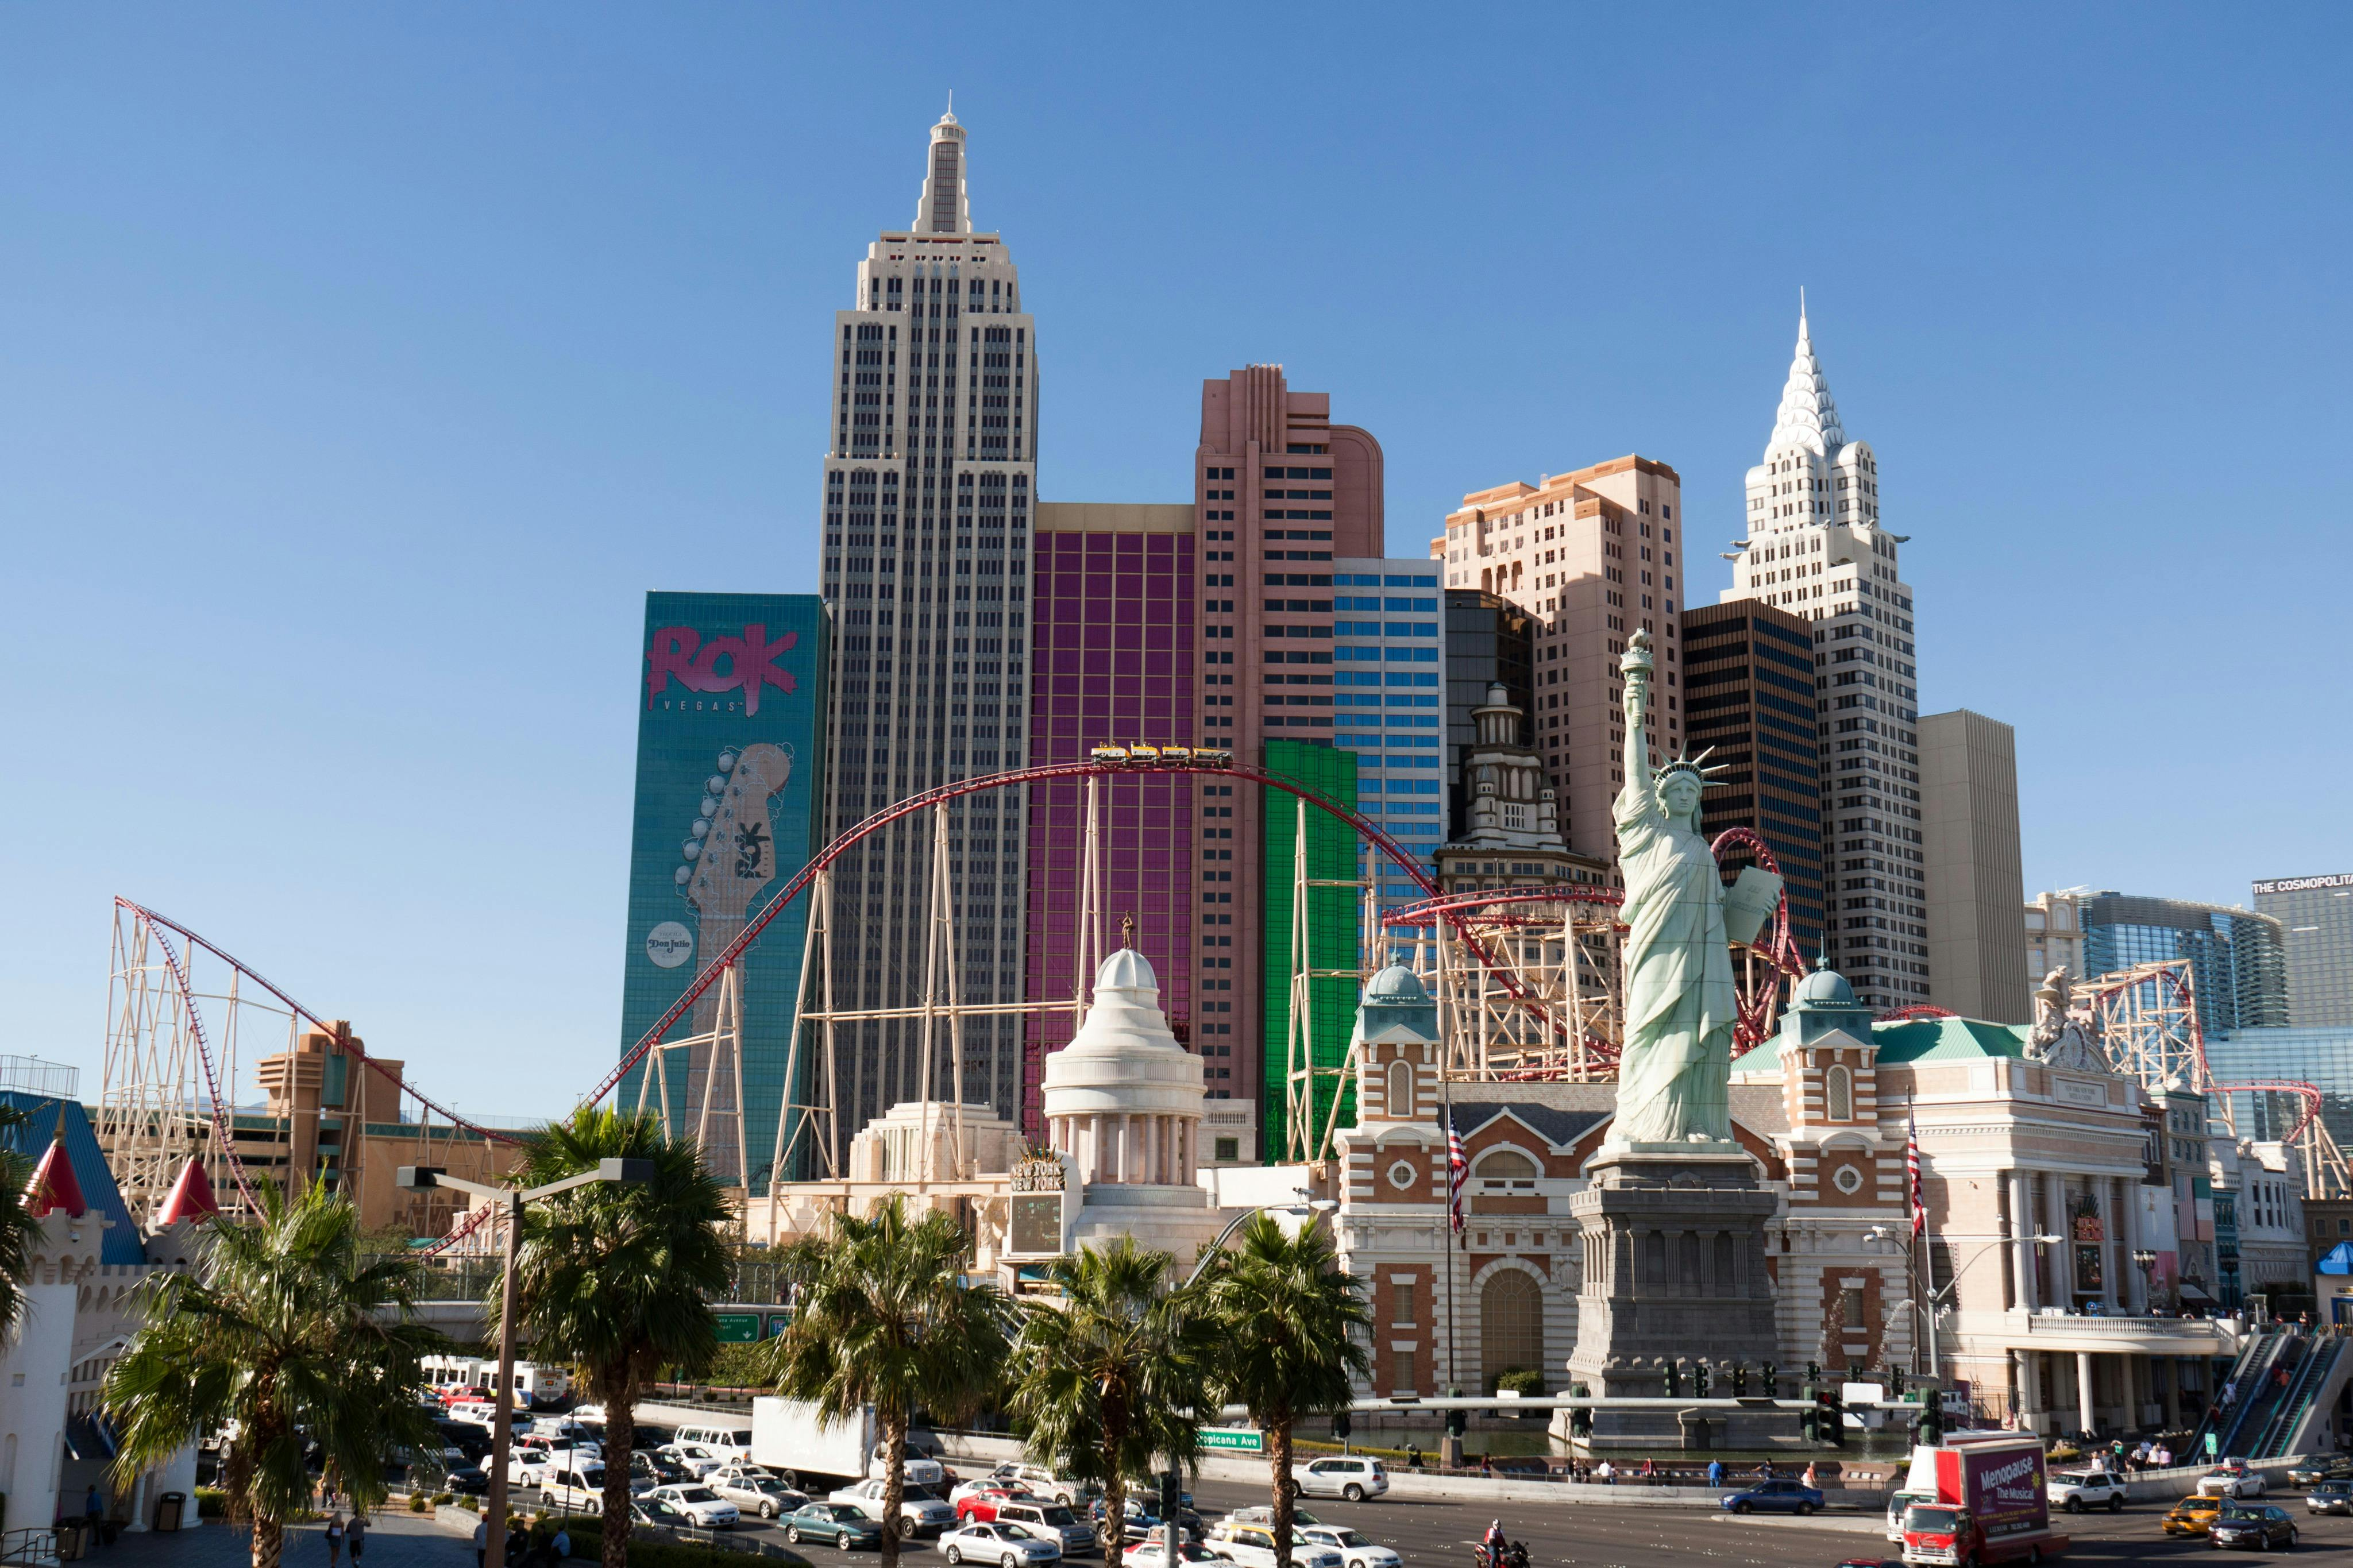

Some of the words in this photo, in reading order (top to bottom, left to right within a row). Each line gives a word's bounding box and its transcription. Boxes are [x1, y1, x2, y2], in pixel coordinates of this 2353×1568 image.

[646, 623, 799, 718] ROK
[2251, 882, 2275, 894] THE
[648, 939, 669, 949] Don
[667, 939, 690, 953] Julio
[1010, 1162, 1032, 1177] NEW
[1033, 1162, 1062, 1177] YORK
[1010, 1176, 1032, 1191] NEW
[1033, 1175, 1062, 1191] YORK
[774, 1323, 783, 1332] 15
[1241, 1436, 1257, 1446] Ave
[1980, 1455, 2034, 1492] Menopause
[1996, 1486, 2009, 1499] The
[1988, 1524, 2008, 1533] LUXOR
